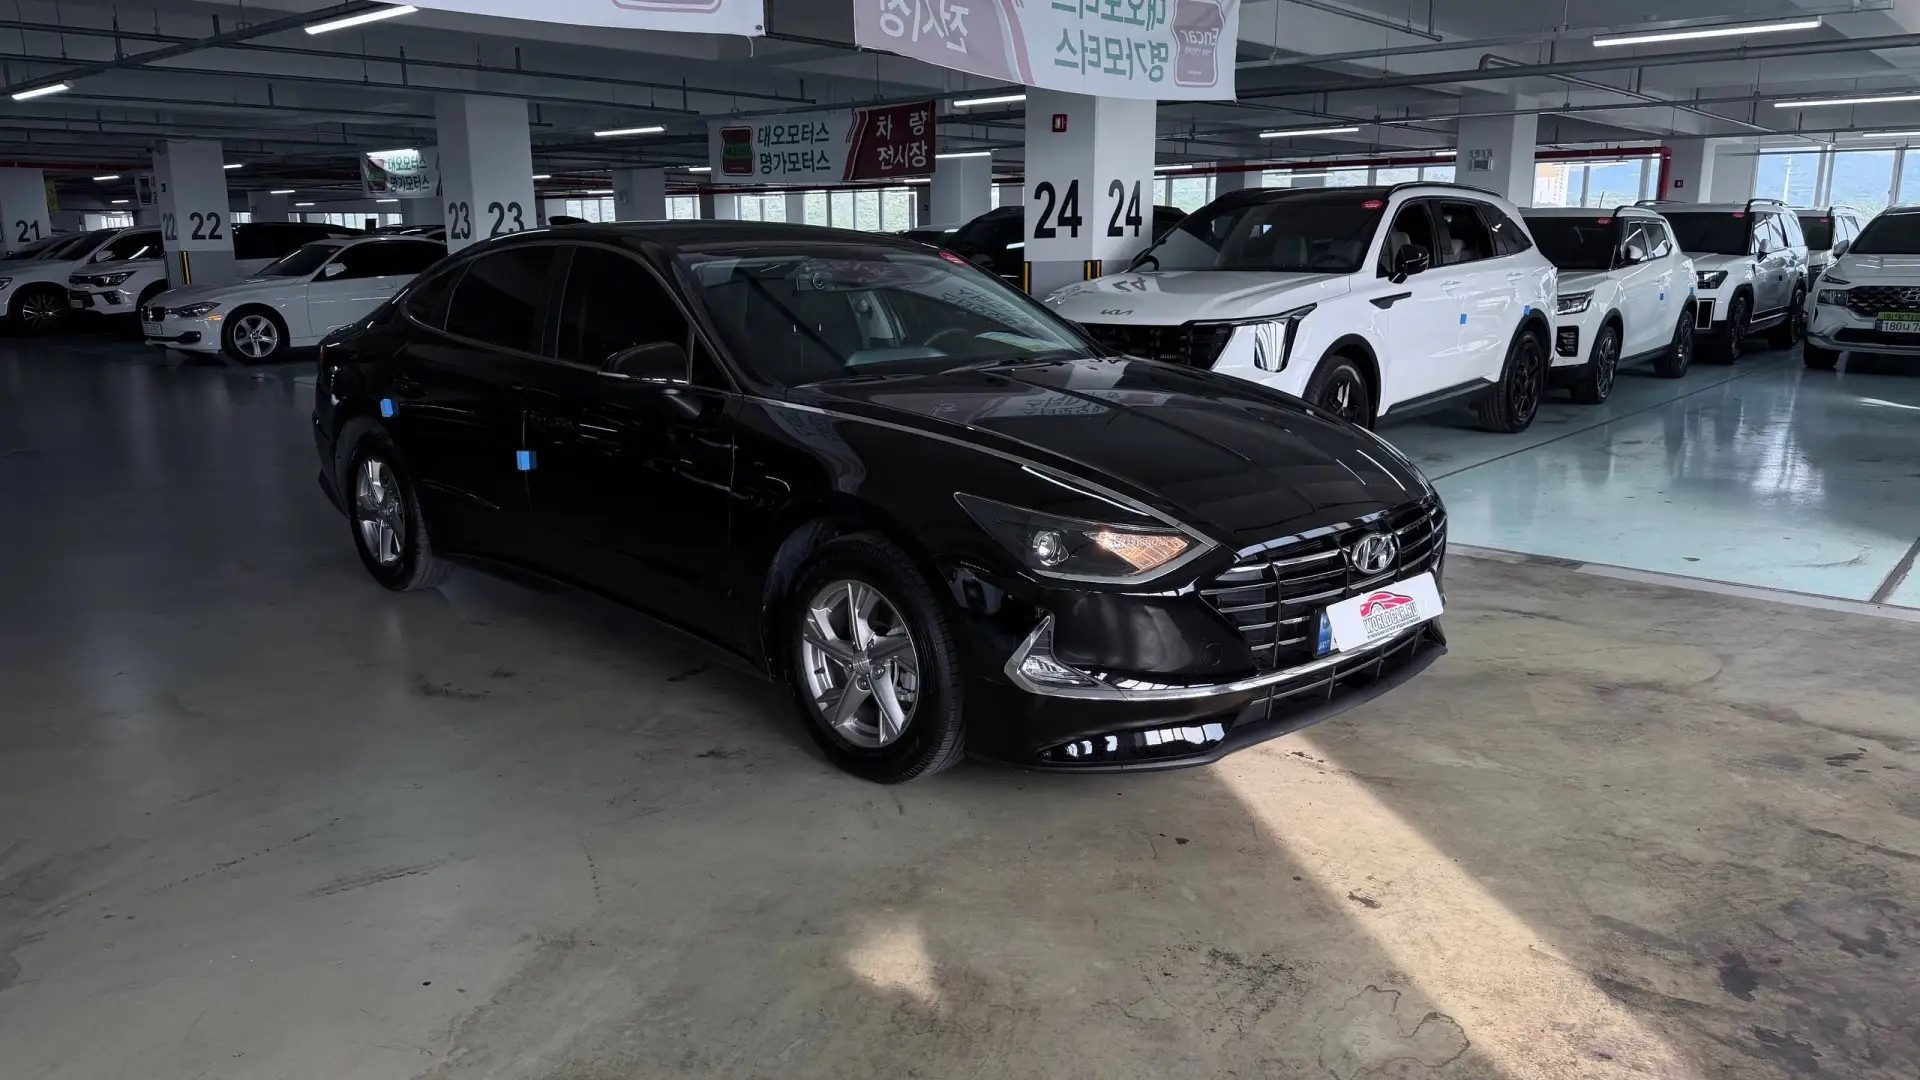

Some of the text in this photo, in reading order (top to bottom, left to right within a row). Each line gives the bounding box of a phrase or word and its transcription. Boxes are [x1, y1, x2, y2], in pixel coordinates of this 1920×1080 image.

[757, 121, 830, 147] 대오모터스
[876, 111, 928, 140] 차 량
[759, 150, 831, 175] 명가모터스
[877, 140, 928, 170] 전시장
[448, 201, 471, 240] 23
[488, 201, 525, 237] 23
[1033, 179, 1083, 239] 24
[1107, 179, 1143, 238] 24
[15, 219, 41, 243] 21
[162, 212, 177, 241] 22
[189, 211, 223, 240] 22
